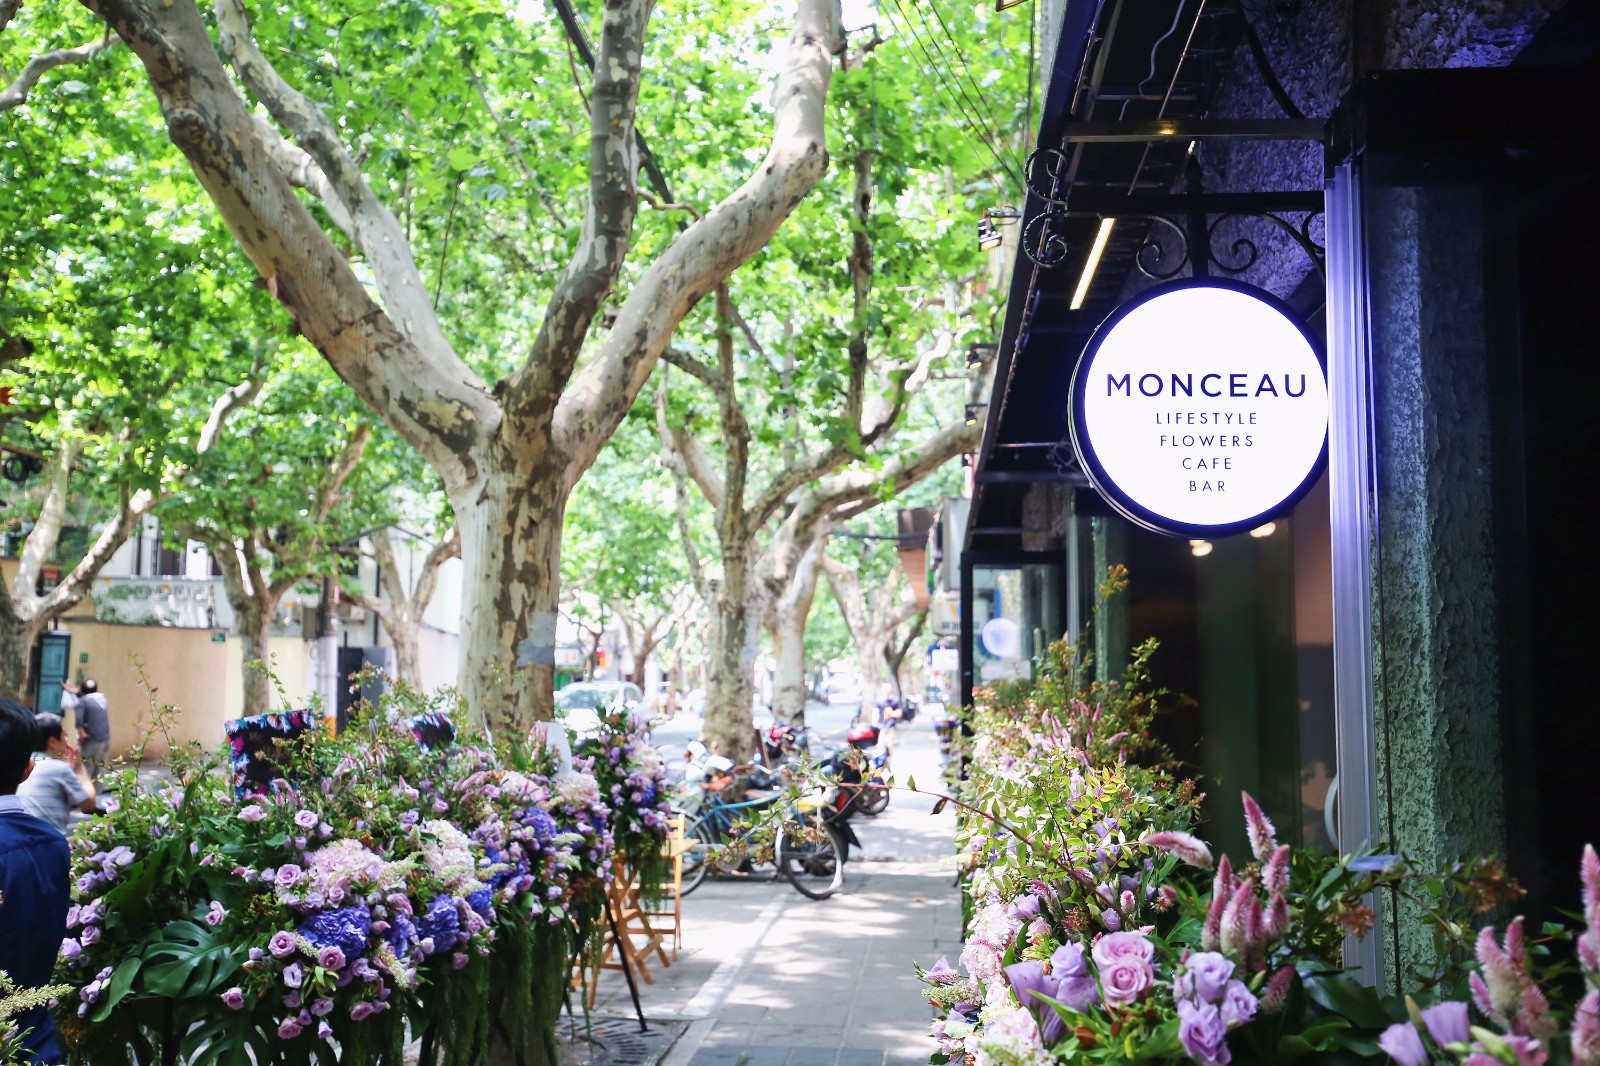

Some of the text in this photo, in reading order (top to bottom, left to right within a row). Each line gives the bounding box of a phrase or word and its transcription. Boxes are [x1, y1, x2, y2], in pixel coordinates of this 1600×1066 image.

[1107, 373, 1306, 398] MONCEAU
[1156, 412, 1257, 425] LIFESTYLE
[1160, 435, 1253, 447] FLOWERS
[1182, 457, 1232, 470] CAFE
[1189, 480, 1225, 492] BAR
